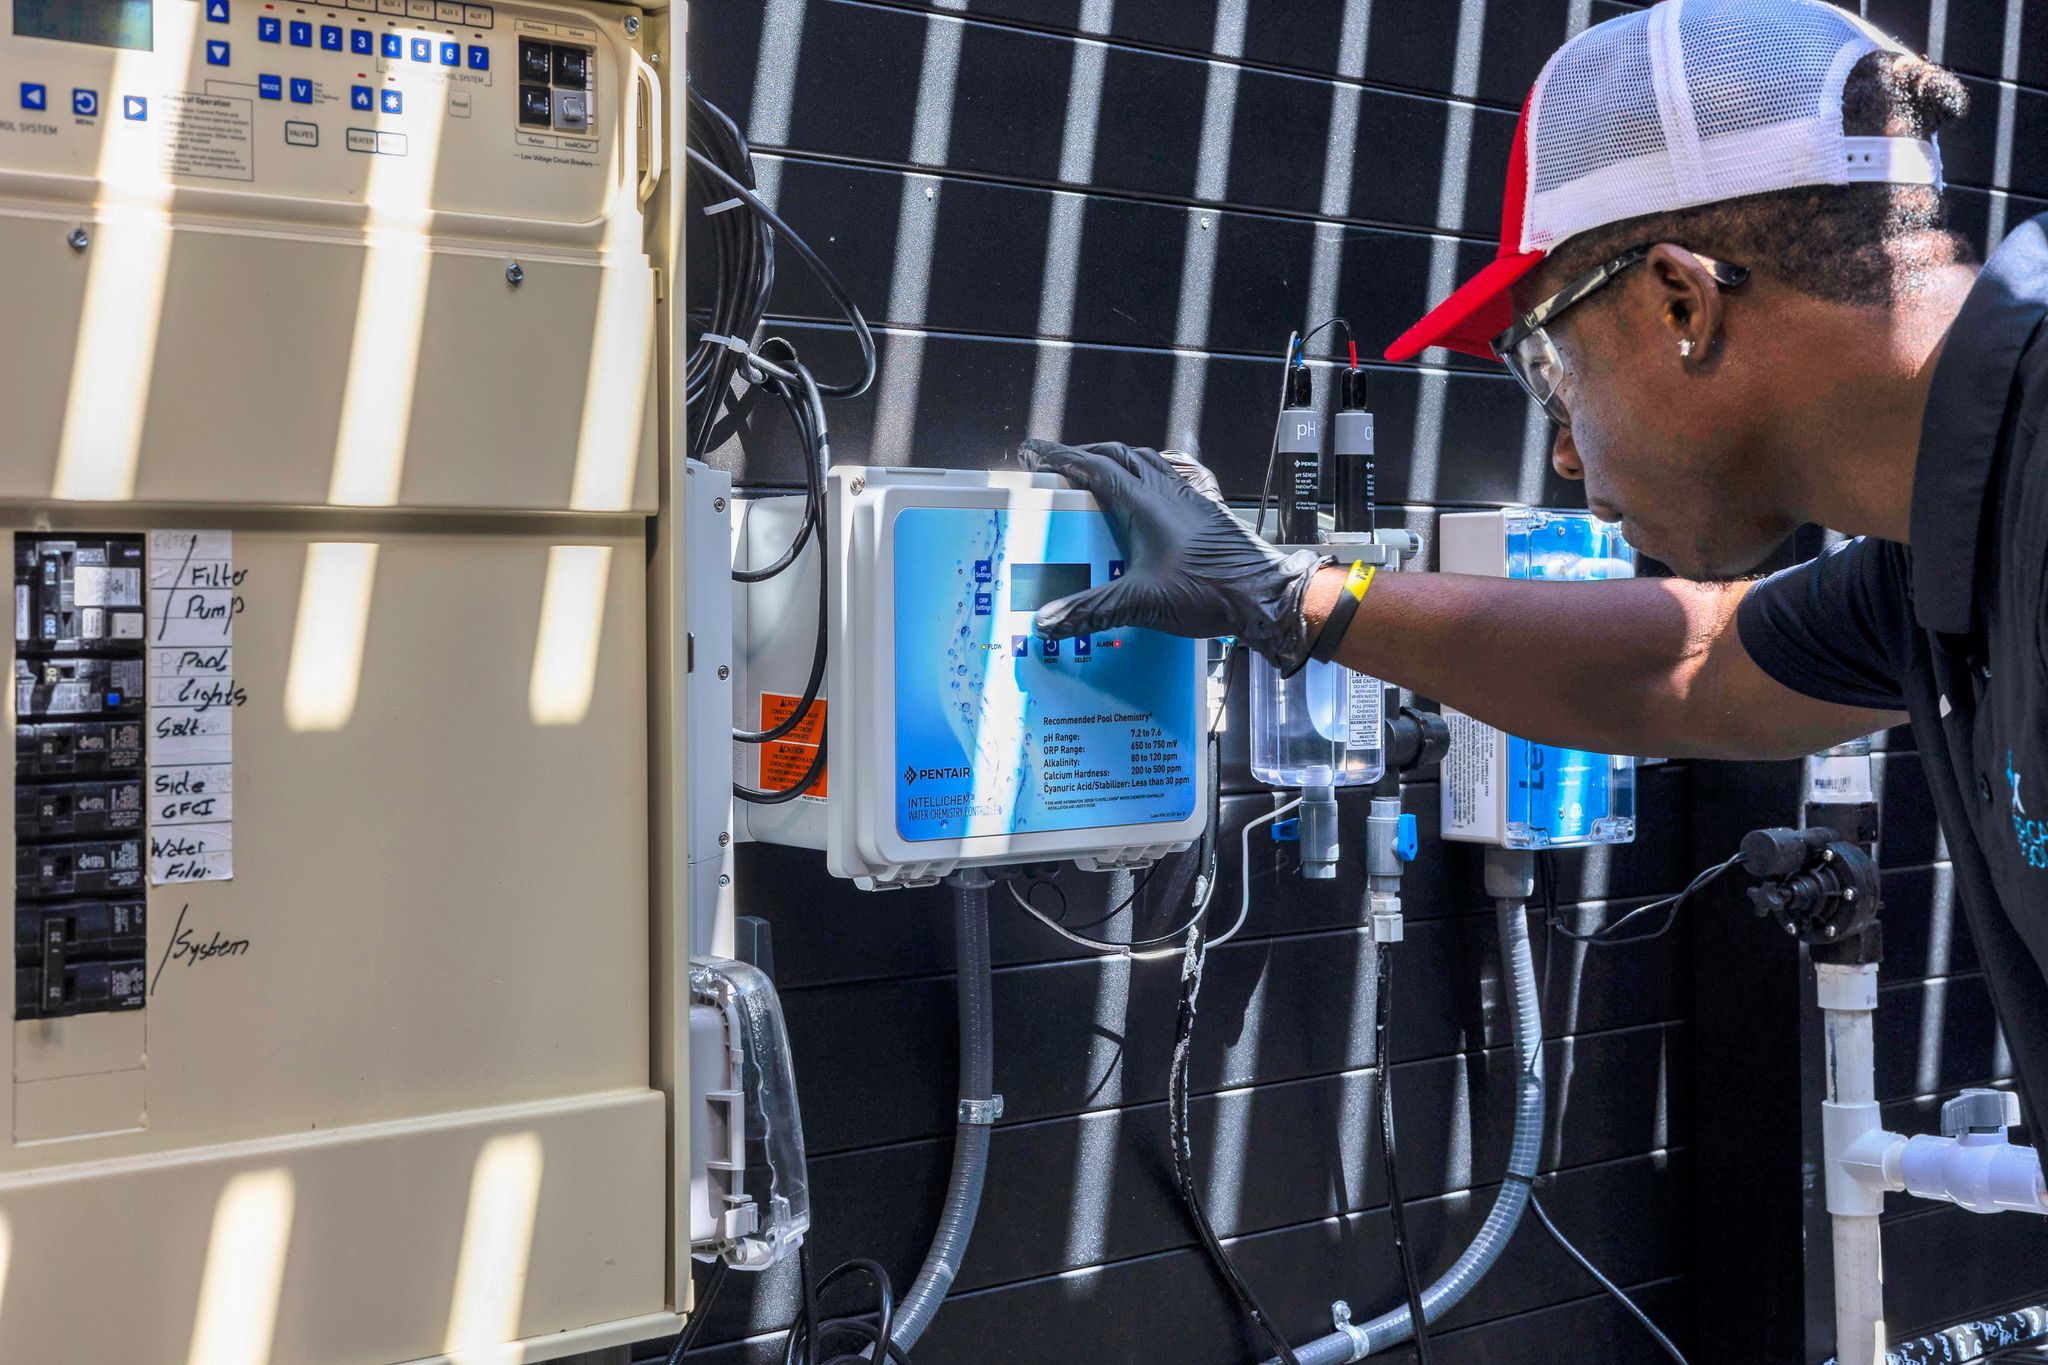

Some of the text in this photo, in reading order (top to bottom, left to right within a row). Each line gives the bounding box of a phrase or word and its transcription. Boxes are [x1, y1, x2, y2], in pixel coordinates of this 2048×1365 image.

[412, 4, 424, 12] AUX
[470, 12, 481, 20] AUX
[266, 24, 274, 36] F
[523, 23, 549, 32] Electronics
[568, 29, 584, 38] Valves
[298, 28, 304, 40] 1
[328, 32, 336, 44] 2
[358, 36, 366, 48] 3
[388, 41, 396, 52] 4
[417, 45, 426, 56] 5
[446, 48, 454, 60] 6
[474, 52, 482, 64] 7
[460, 74, 484, 84] SYSTEM
[261, 82, 280, 92] MODE
[297, 84, 306, 97] V
[451, 101, 469, 110] Reset
[75, 118, 96, 126] MENU
[20, 122, 58, 135] SYSTEM
[288, 128, 314, 140] VALVES
[350, 136, 374, 146] HEATER
[533, 154, 552, 164] Voltage
[552, 156, 570, 164] Circuit
[570, 158, 594, 167] Breakers
[1297, 420, 1316, 440] pH
[192, 563, 248, 587] Filter
[185, 594, 245, 635] Pump
[44, 619, 56, 634] 20
[47, 667, 58, 682] 20
[1044, 714, 1096, 726] Recommended
[1097, 714, 1112, 723] Pool
[1044, 734, 1054, 744] pH
[1055, 733, 1080, 743] Range:
[1130, 729, 1142, 738] 7.2
[1151, 728, 1162, 736] 7.6
[1044, 740, 1178, 756] ORP Range: 650 to 750 mV
[1044, 752, 1178, 768] Alkalinity: 80 to 120 ppm
[920, 767, 971, 780] PENTAIR
[1044, 765, 1182, 780] Calcium Hardness: 200 to 500 ppm
[156, 772, 206, 794] Side
[1044, 776, 1190, 795] Cyanuric Acid/Stabilizer: Less than 30 ppm
[162, 800, 216, 820] GFCI
[908, 810, 929, 821] WATER
[930, 806, 963, 820] CHEMISTRY
[152, 838, 205, 859] Water
[174, 930, 249, 967] System
